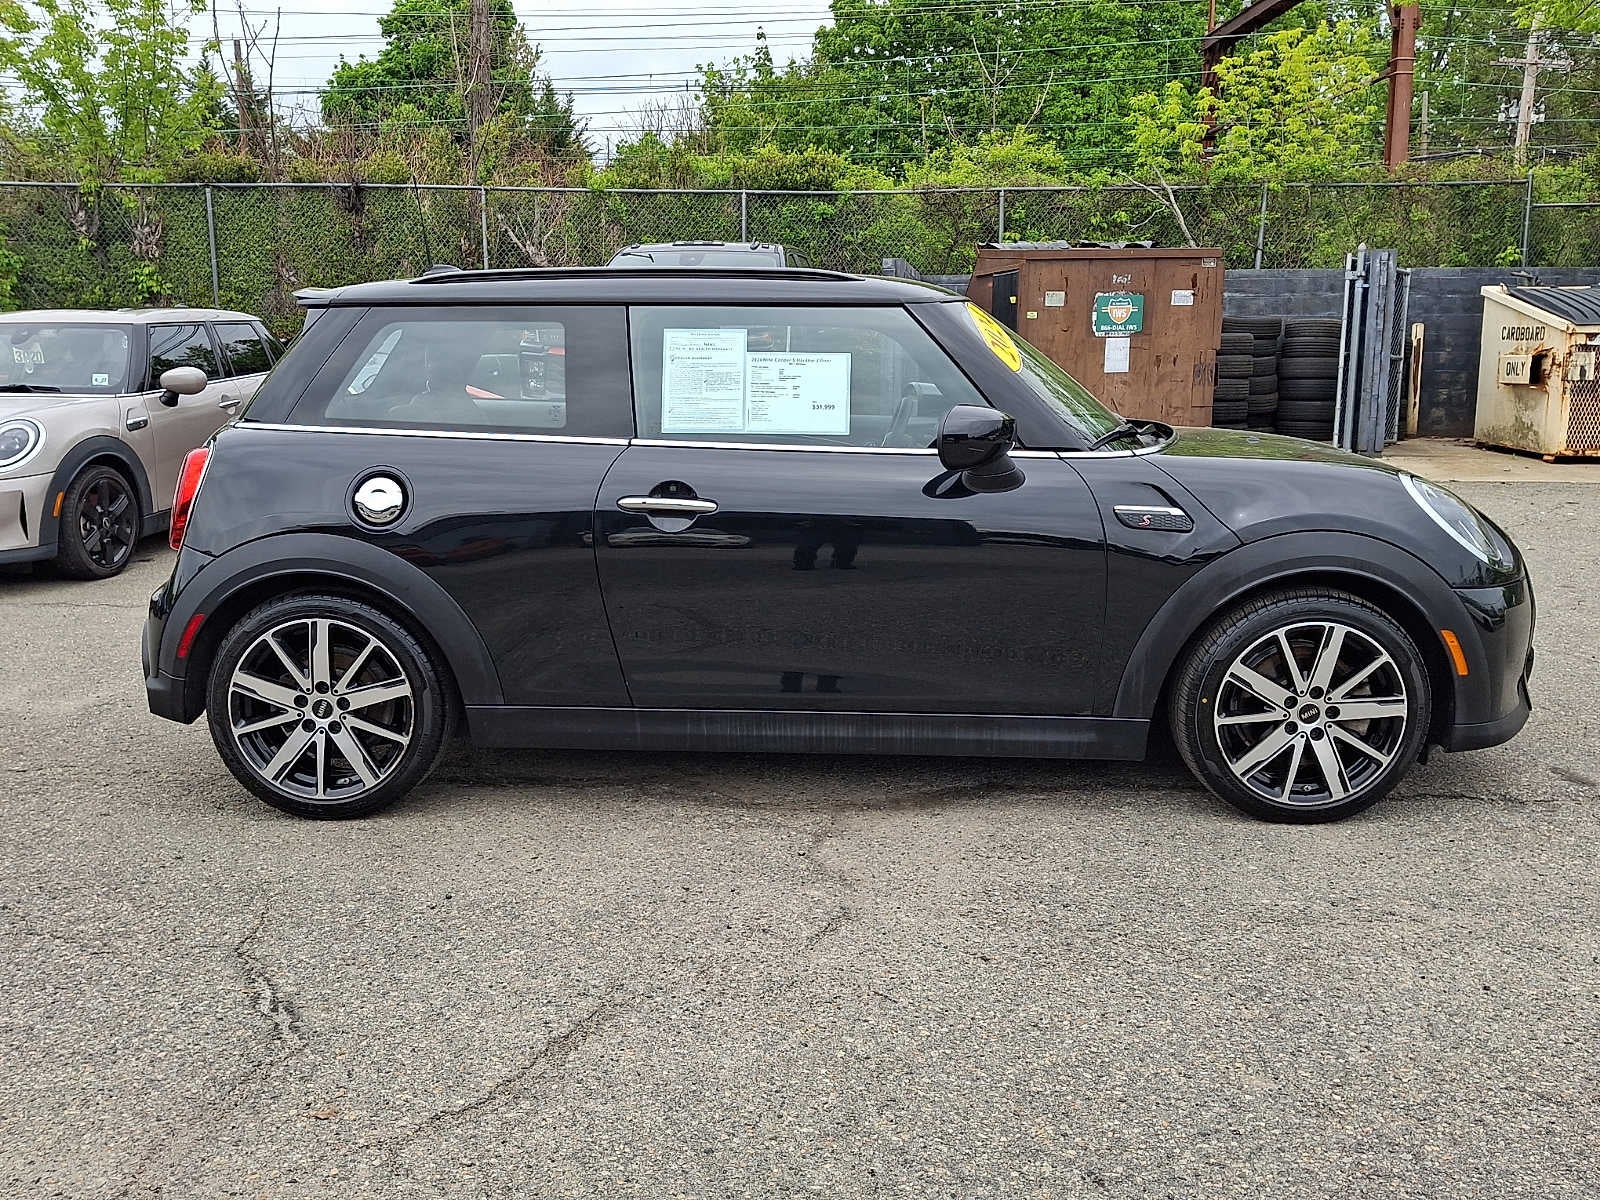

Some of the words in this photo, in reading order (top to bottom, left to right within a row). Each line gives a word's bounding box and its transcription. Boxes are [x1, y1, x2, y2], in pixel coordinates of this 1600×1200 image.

[1501, 326, 1546, 342] CARDBOARD
[1505, 361, 1525, 377] ONLY
[1138, 514, 1152, 527] S
[1301, 707, 1318, 720] MINI
